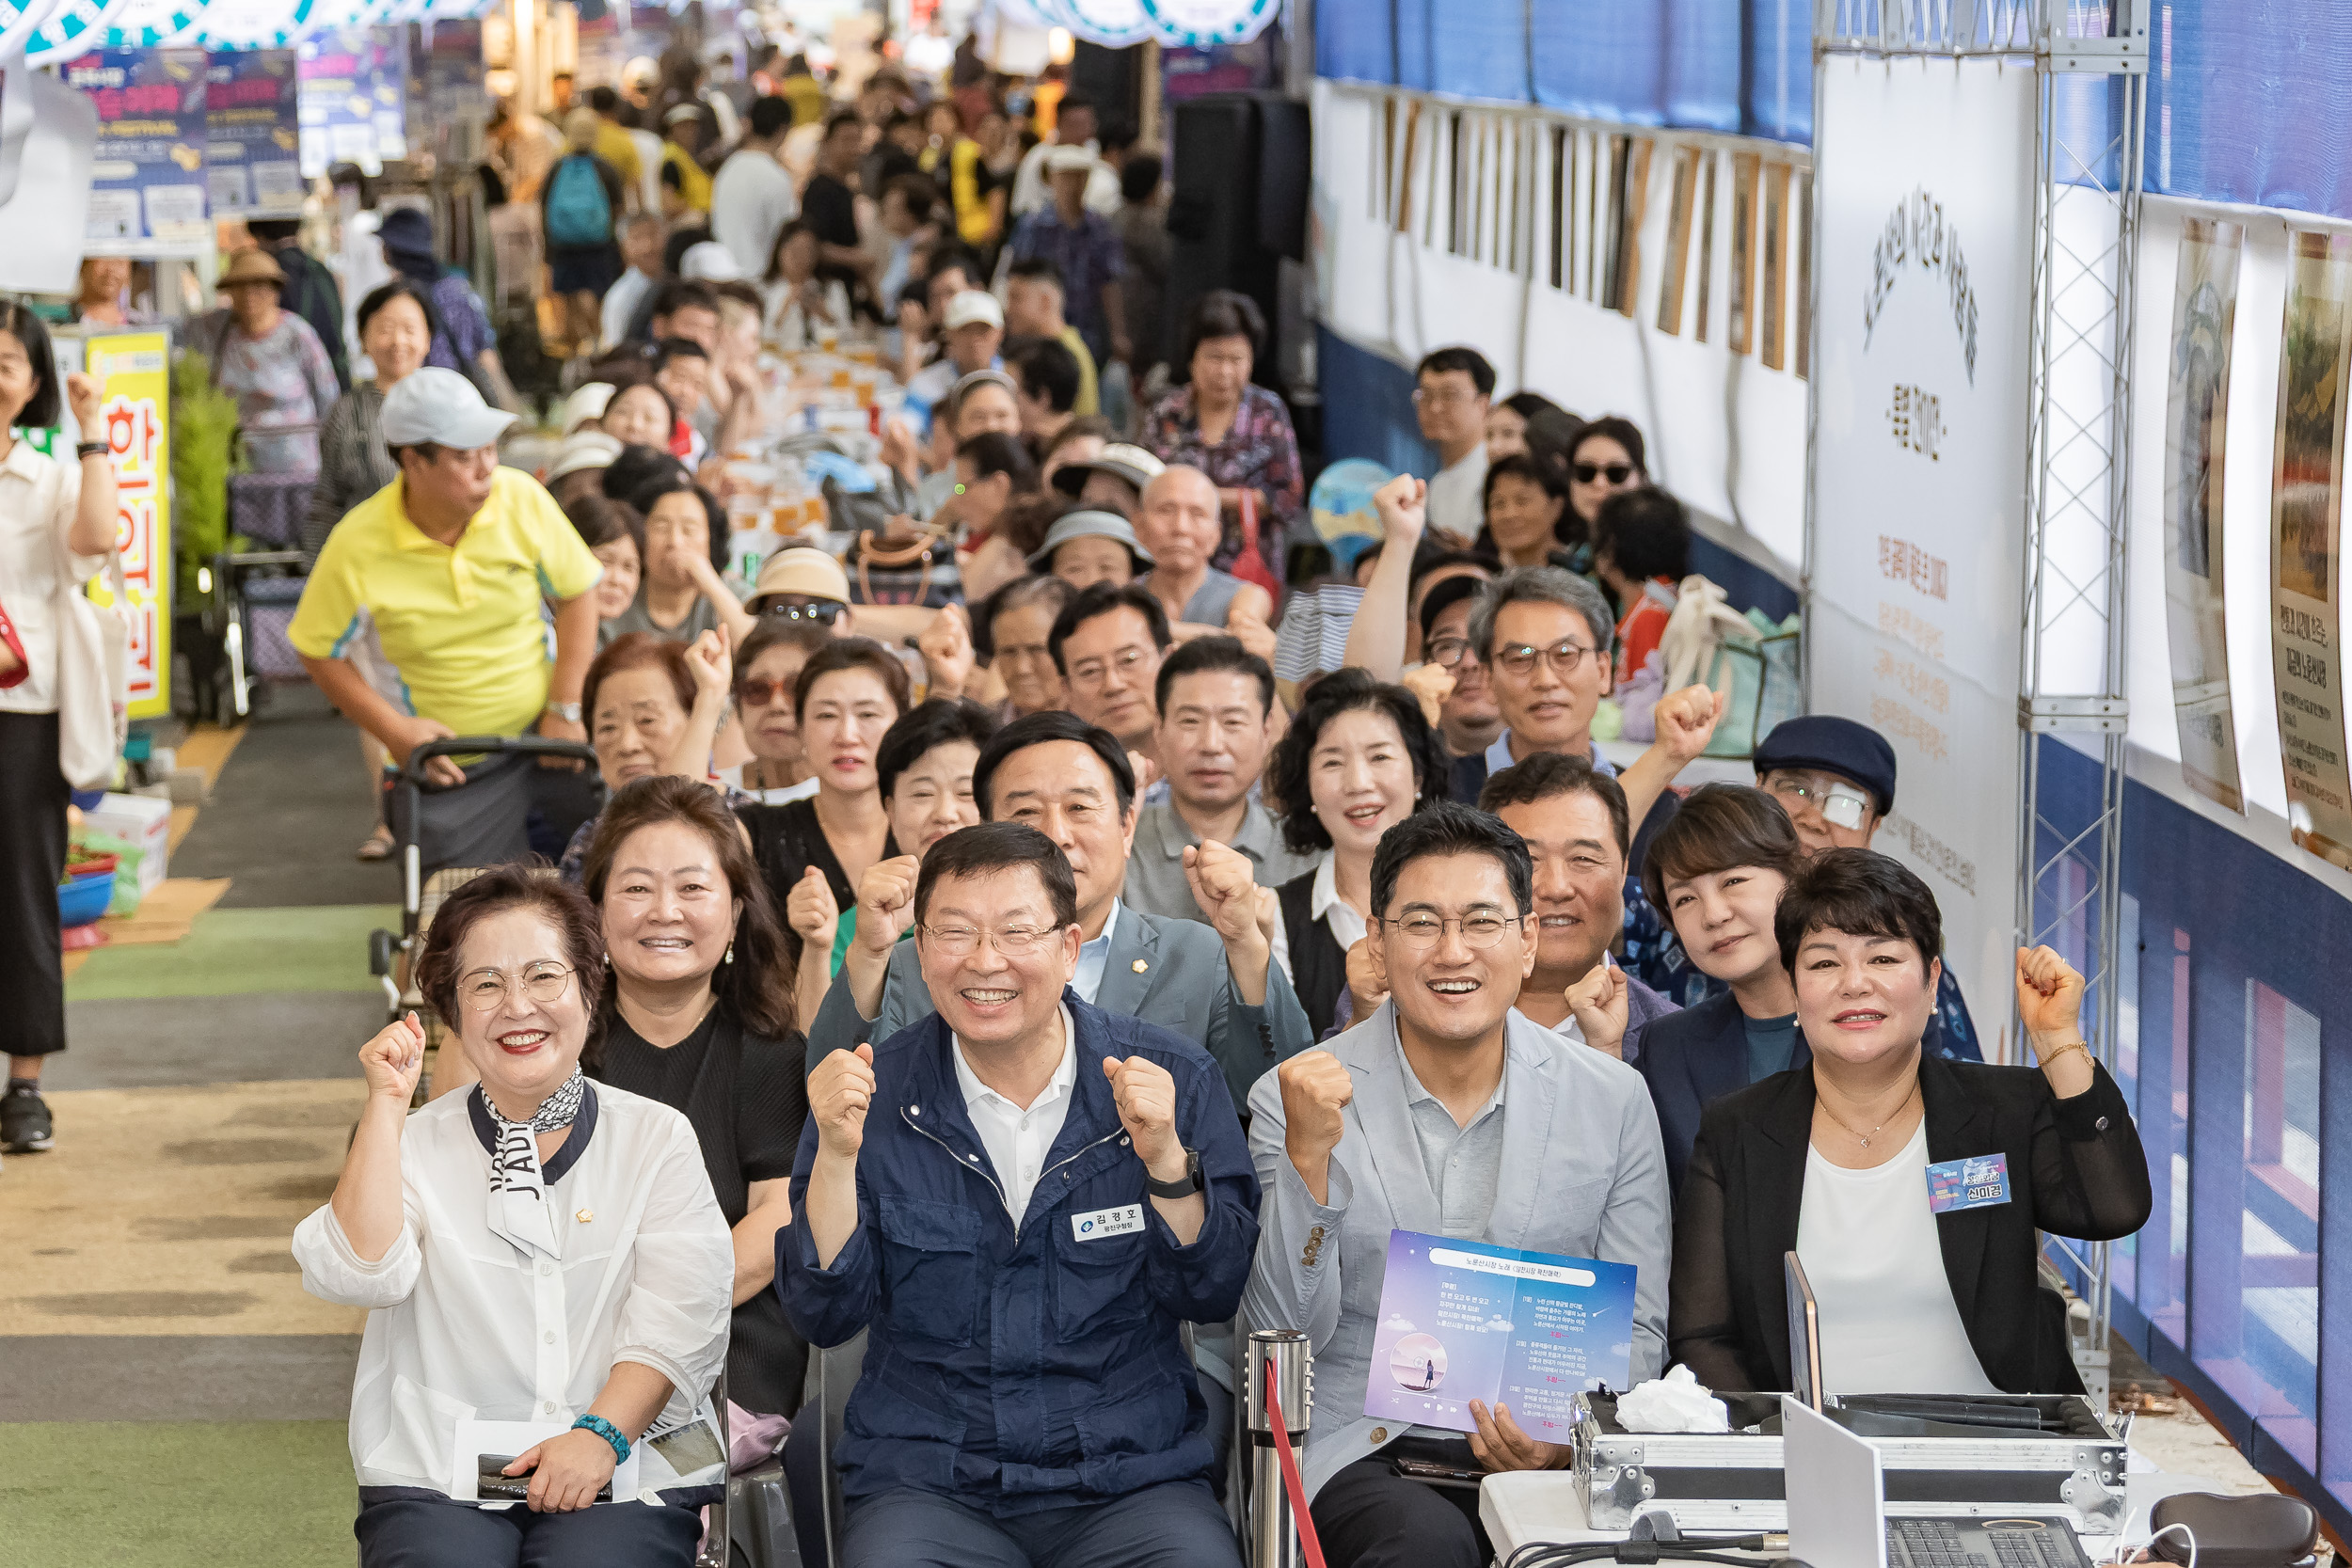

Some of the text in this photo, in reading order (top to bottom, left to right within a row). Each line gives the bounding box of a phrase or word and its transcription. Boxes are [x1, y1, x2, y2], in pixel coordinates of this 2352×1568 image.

[1968, 1185, 2001, 1199] 신미경
[1104, 1222, 1133, 1232] 광진구청장
[1466, 1258, 1497, 1269] 노룬산시장
[1498, 1262, 1511, 1272] 노래
[1478, 1297, 1489, 1306] 오고
